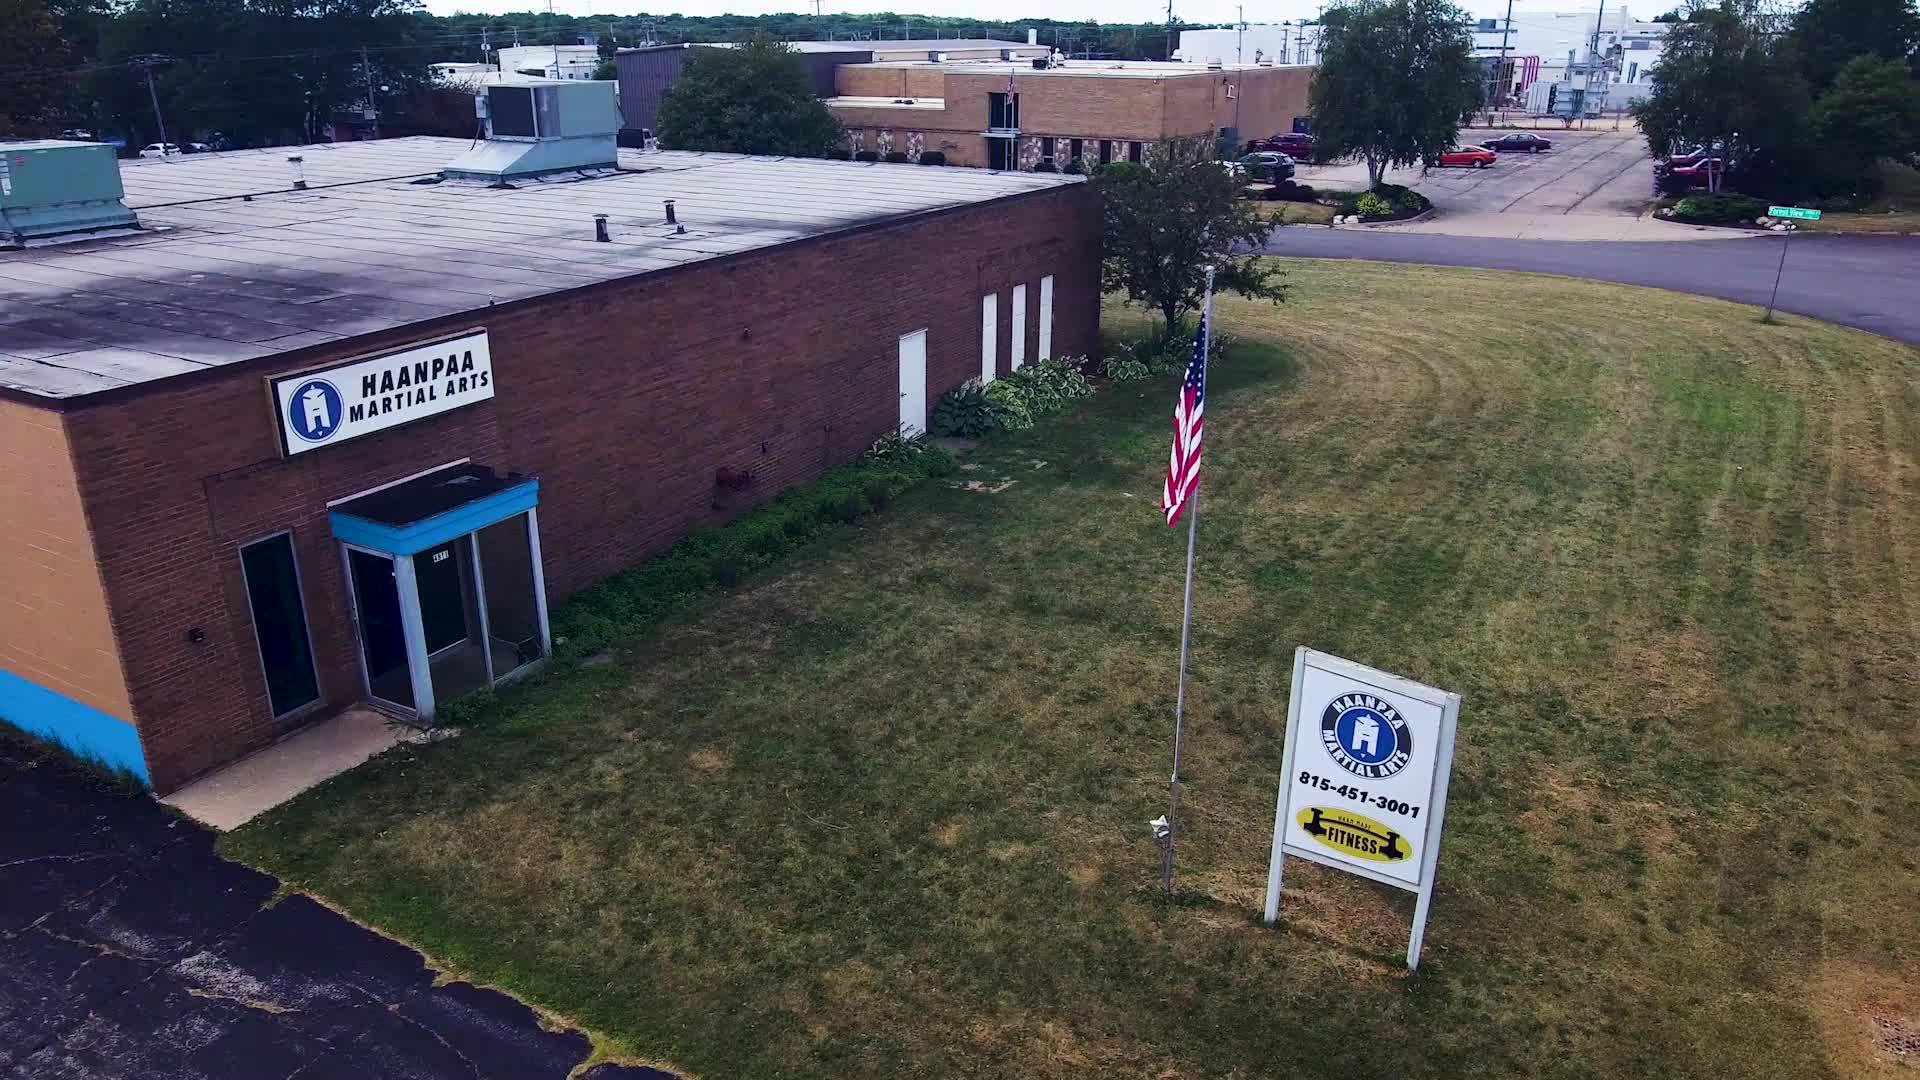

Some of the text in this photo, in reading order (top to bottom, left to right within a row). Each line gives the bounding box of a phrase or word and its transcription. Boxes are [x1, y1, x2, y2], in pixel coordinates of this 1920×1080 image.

[1769, 207, 1788, 216] Forest
[1789, 208, 1804, 217] View
[349, 371, 488, 423] MARTIAL ARTS
[362, 350, 474, 398] HAANPAA
[1332, 695, 1404, 730] HAANPAA
[1322, 729, 1409, 777] MARTIAL ARTS
[1299, 771, 1421, 819] 815-451-3001
[1327, 826, 1378, 854] FITNESS
